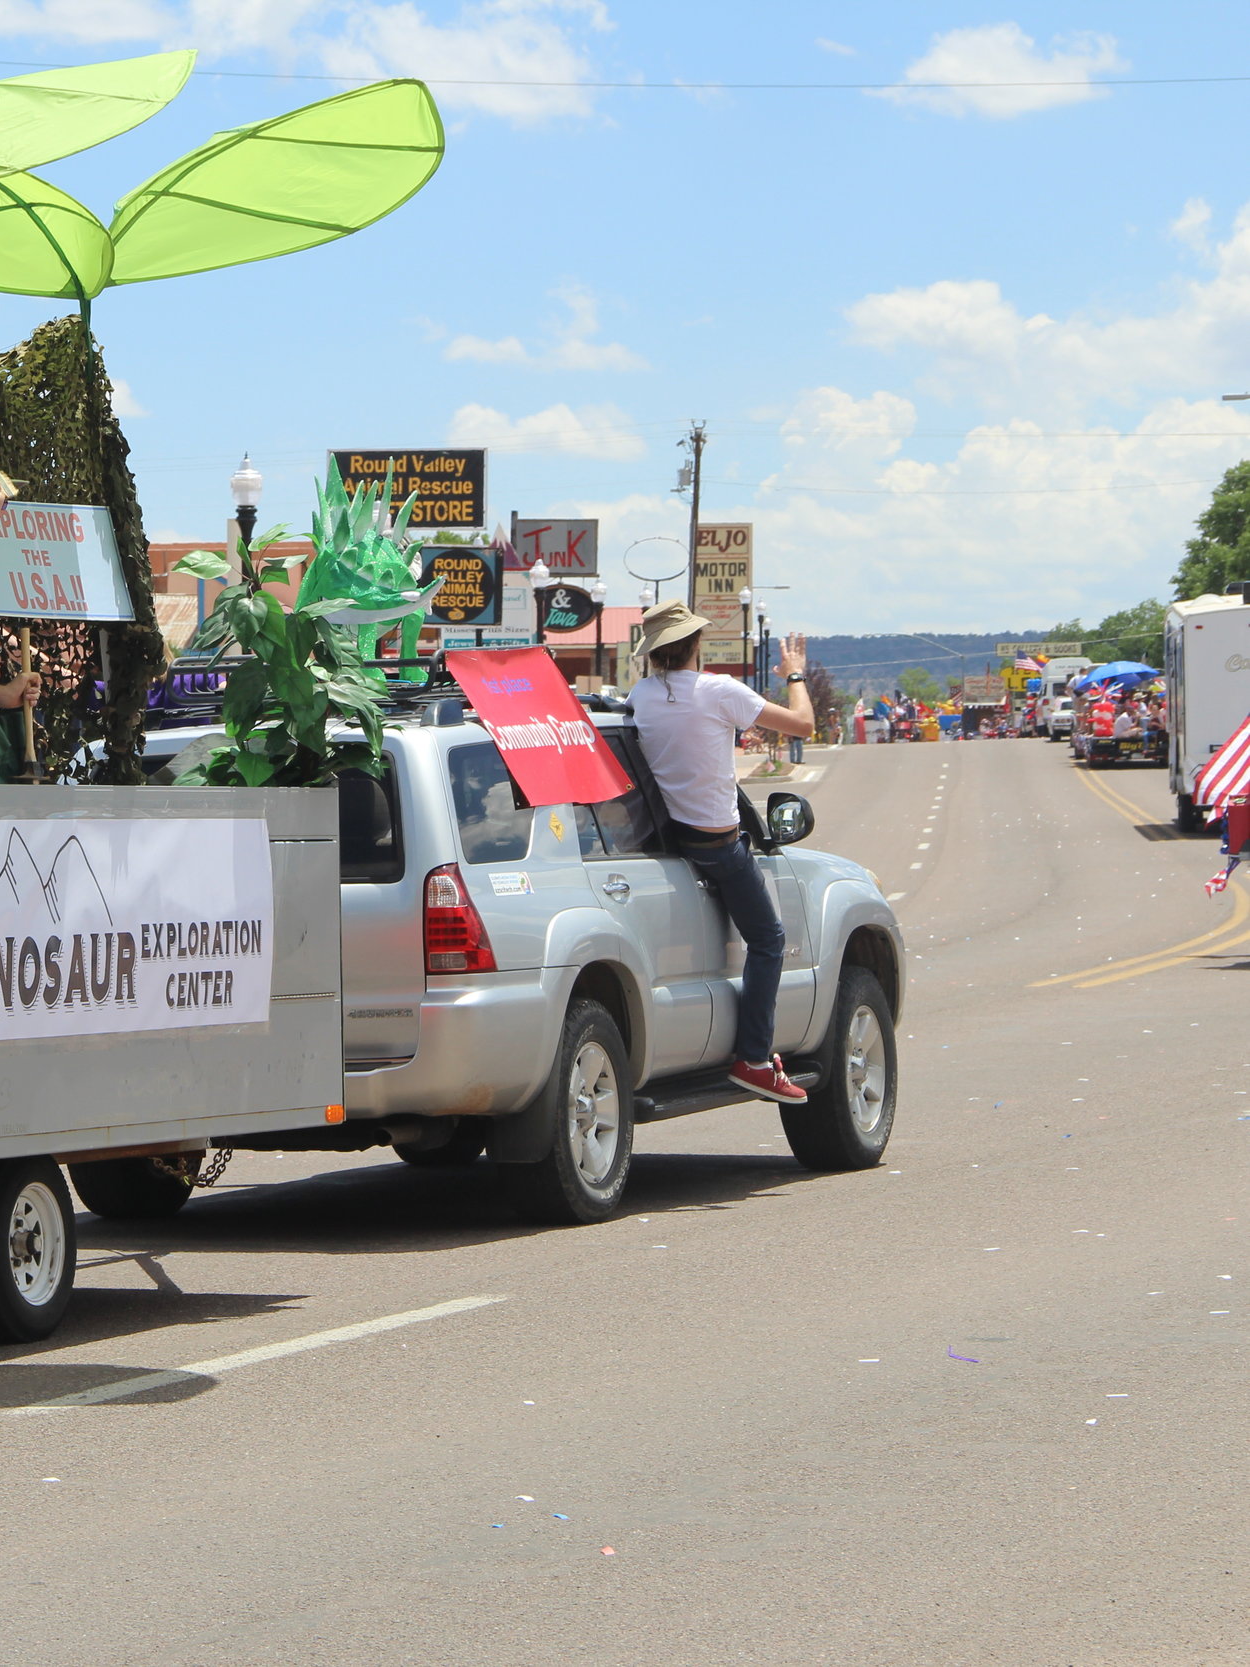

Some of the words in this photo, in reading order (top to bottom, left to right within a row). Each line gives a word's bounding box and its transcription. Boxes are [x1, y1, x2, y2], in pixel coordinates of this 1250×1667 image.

[350, 455, 407, 474] Round
[412, 455, 466, 477] Valley
[408, 477, 473, 495] Rescue
[411, 500, 474, 522] STORE
[522, 525, 588, 568] JUNK
[21, 549, 52, 567] THE
[434, 558, 483, 571] ROUND
[432, 571, 485, 583] VALLEY
[696, 562, 747, 577] MOTOR
[8, 571, 89, 612] U.S.A.!!
[708, 579, 734, 593] INN
[431, 595, 486, 608] RESCUE
[551, 588, 572, 609] &
[543, 607, 579, 628] Java
[483, 716, 562, 754] Community
[546, 714, 596, 753] Group
[140, 920, 262, 959] EXPLORATION
[166, 970, 234, 1009] CENTER
